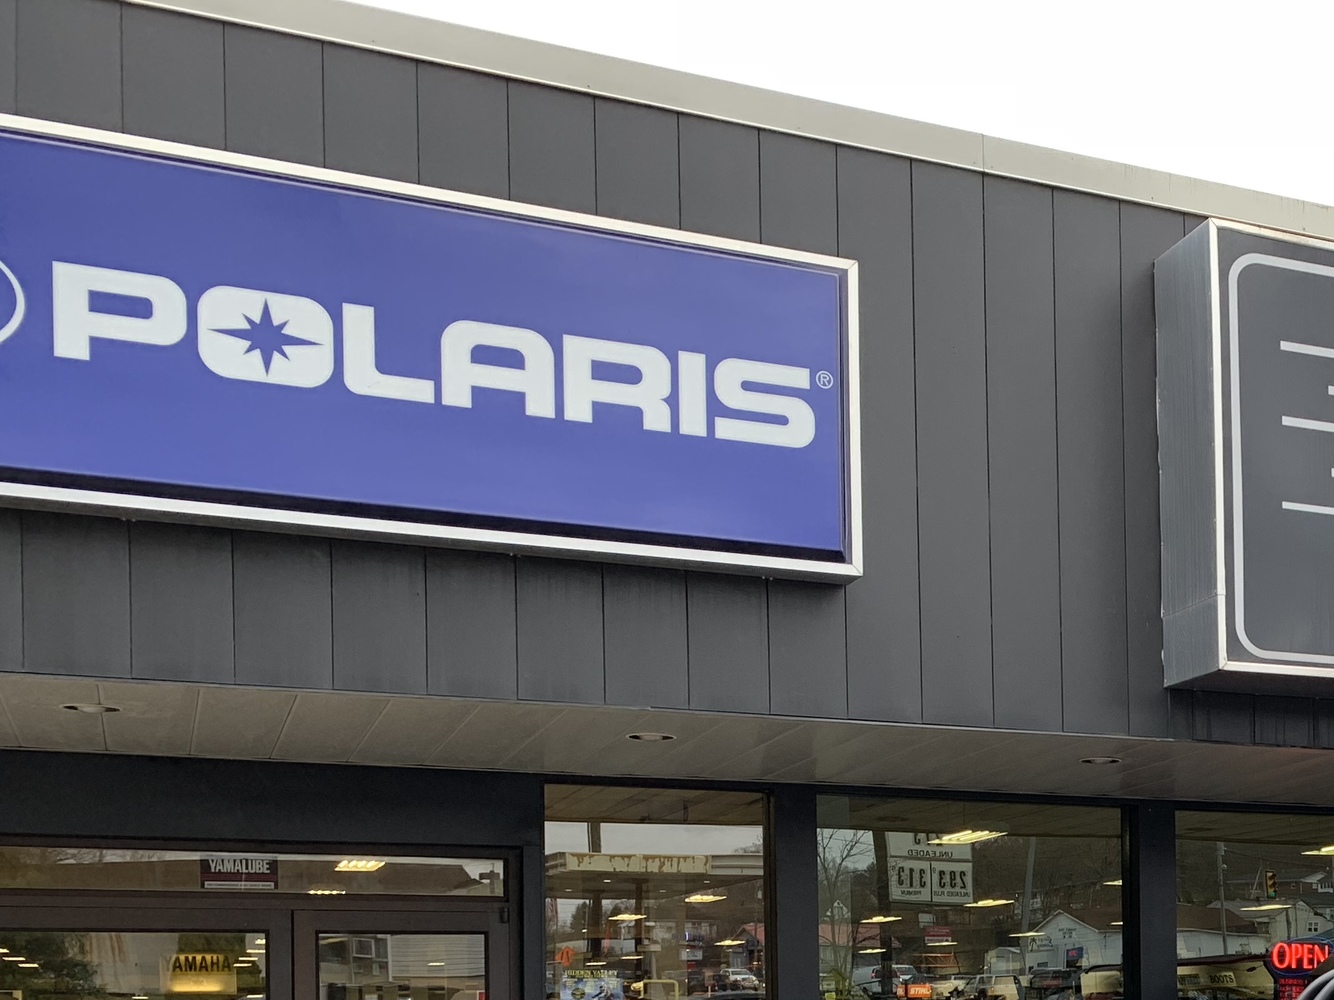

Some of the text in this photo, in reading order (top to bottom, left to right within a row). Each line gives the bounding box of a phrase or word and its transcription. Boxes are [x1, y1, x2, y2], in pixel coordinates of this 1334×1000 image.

[52, 260, 816, 449] POLARIS
[209, 857, 271, 873] YAMALUBE
[1272, 942, 1329, 969] OPEN
[1209, 974, 1234, 984] BOOTS
[909, 987, 931, 995] STIHL
